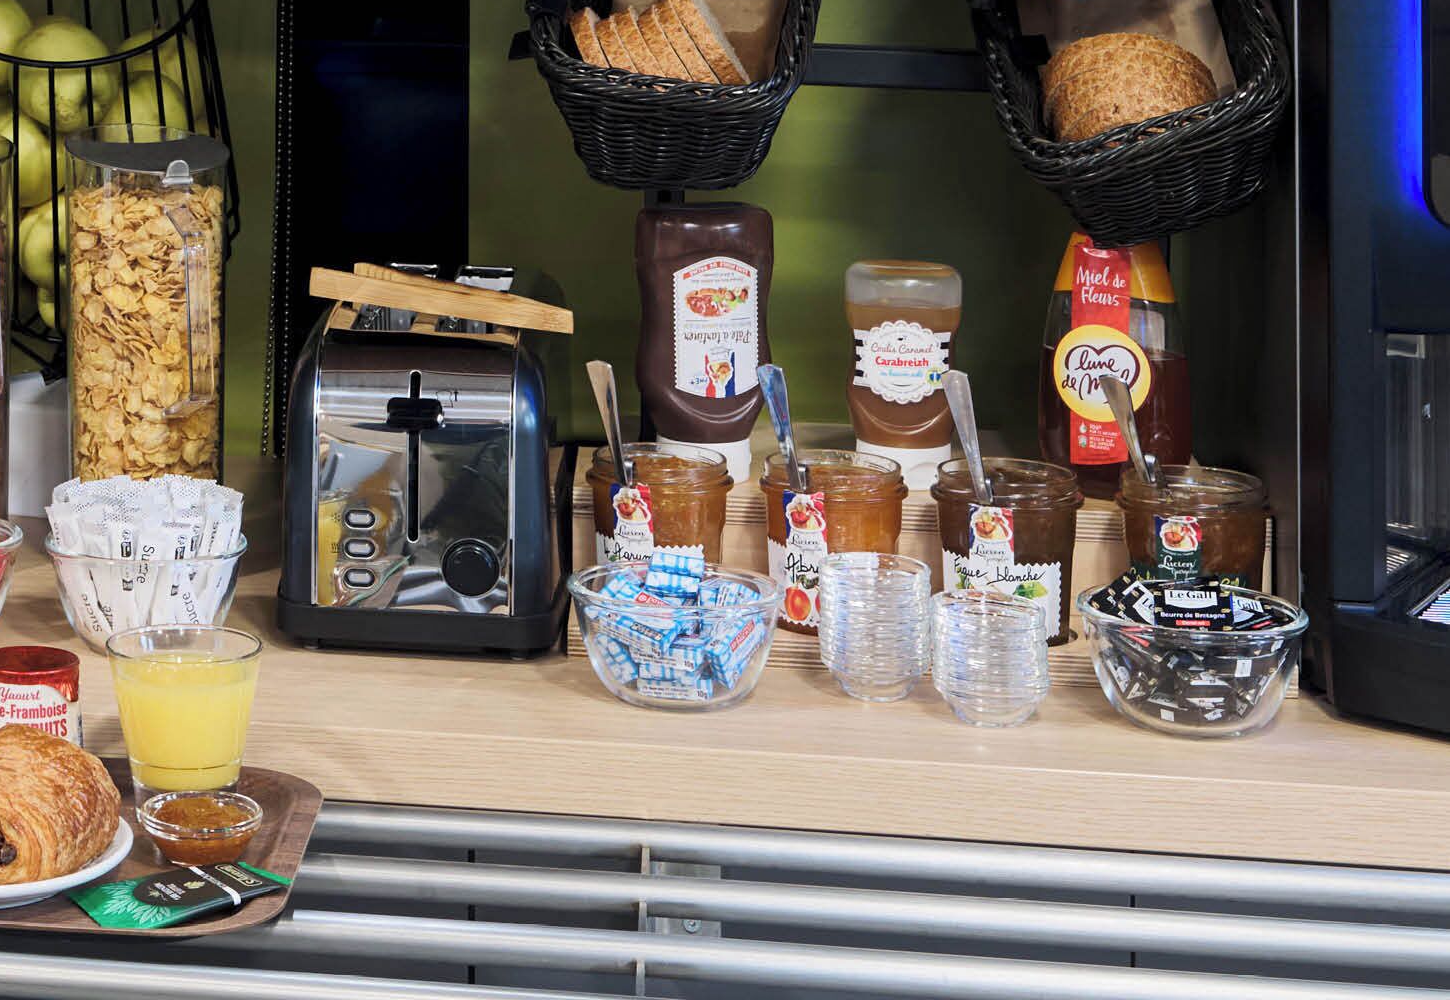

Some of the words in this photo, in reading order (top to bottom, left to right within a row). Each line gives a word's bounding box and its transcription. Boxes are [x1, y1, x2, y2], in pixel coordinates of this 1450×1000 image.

[1075, 265, 1110, 287] Miel
[1112, 273, 1127, 289] de
[1081, 286, 1120, 306] Fleurs
[875, 356, 929, 367] Carabreizh
[1075, 349, 1119, 372] lune
[1061, 374, 1076, 391] de
[784, 552, 820, 584] Abri
[1157, 555, 1196, 571] Lucien
[986, 565, 1046, 585] blanche
[1170, 590, 1184, 599] Le
[1187, 590, 1213, 600] Gall
[1160, 611, 1184, 619] Beurre
[1184, 611, 1193, 619] de
[1194, 612, 1226, 620] Bretagne
[696, 690, 708, 700] 10g
